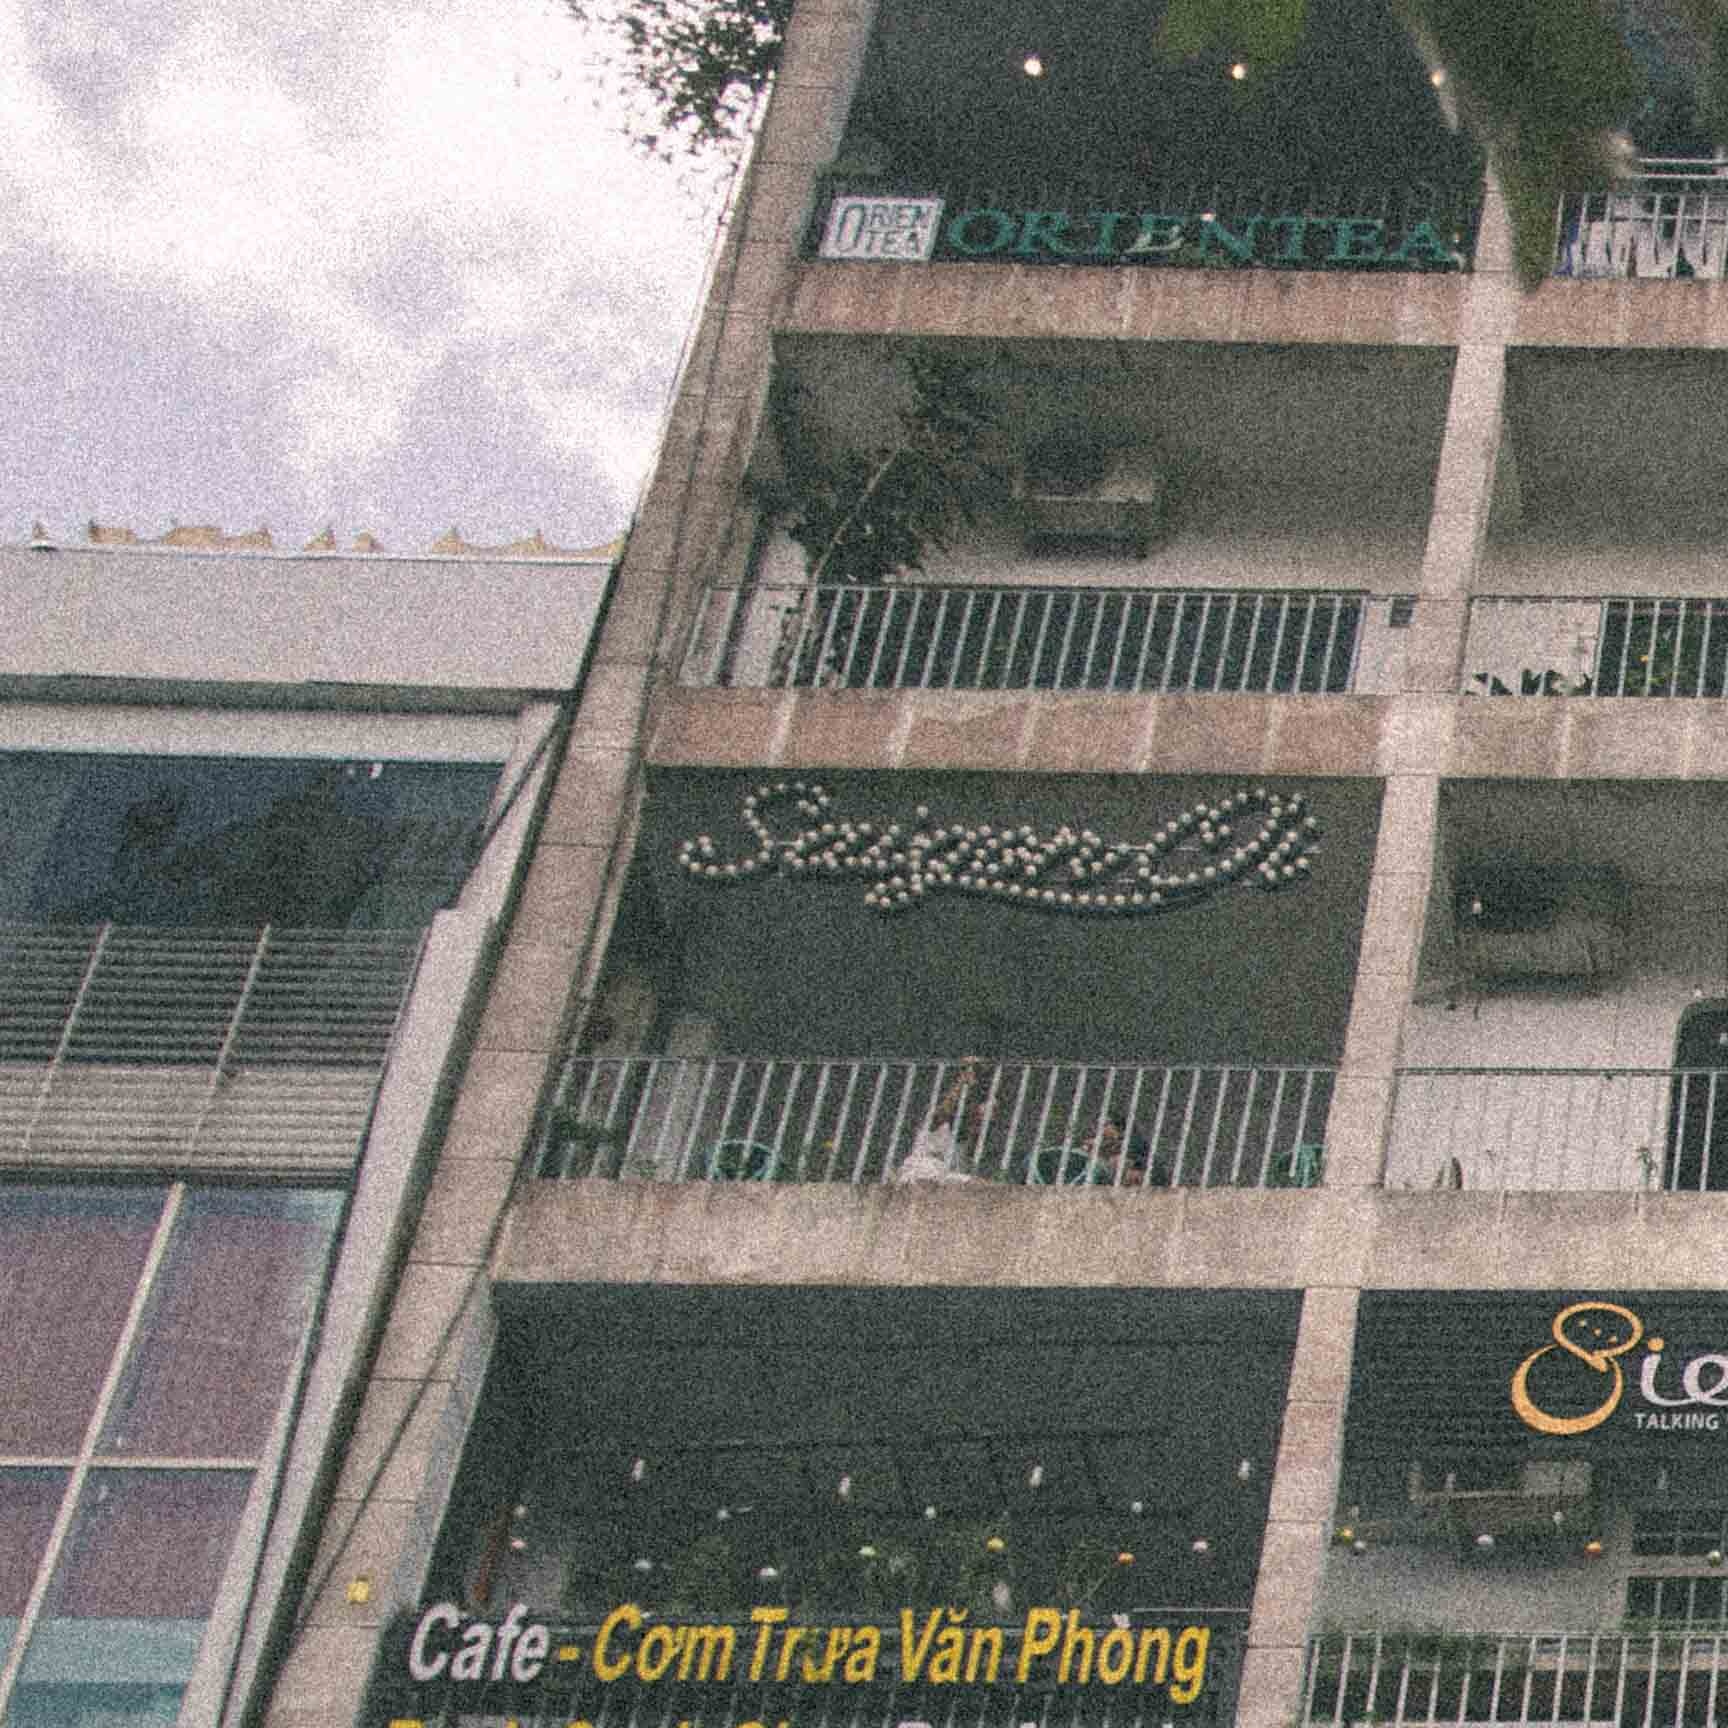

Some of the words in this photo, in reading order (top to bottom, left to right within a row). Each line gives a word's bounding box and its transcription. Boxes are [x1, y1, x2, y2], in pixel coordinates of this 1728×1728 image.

[1633, 1412, 1719, 1432] TALKING
[408, 1602, 551, 1682] Cafe
[899, 1607, 1005, 1684] Văn
[1015, 1606, 1211, 1705] Phòng
